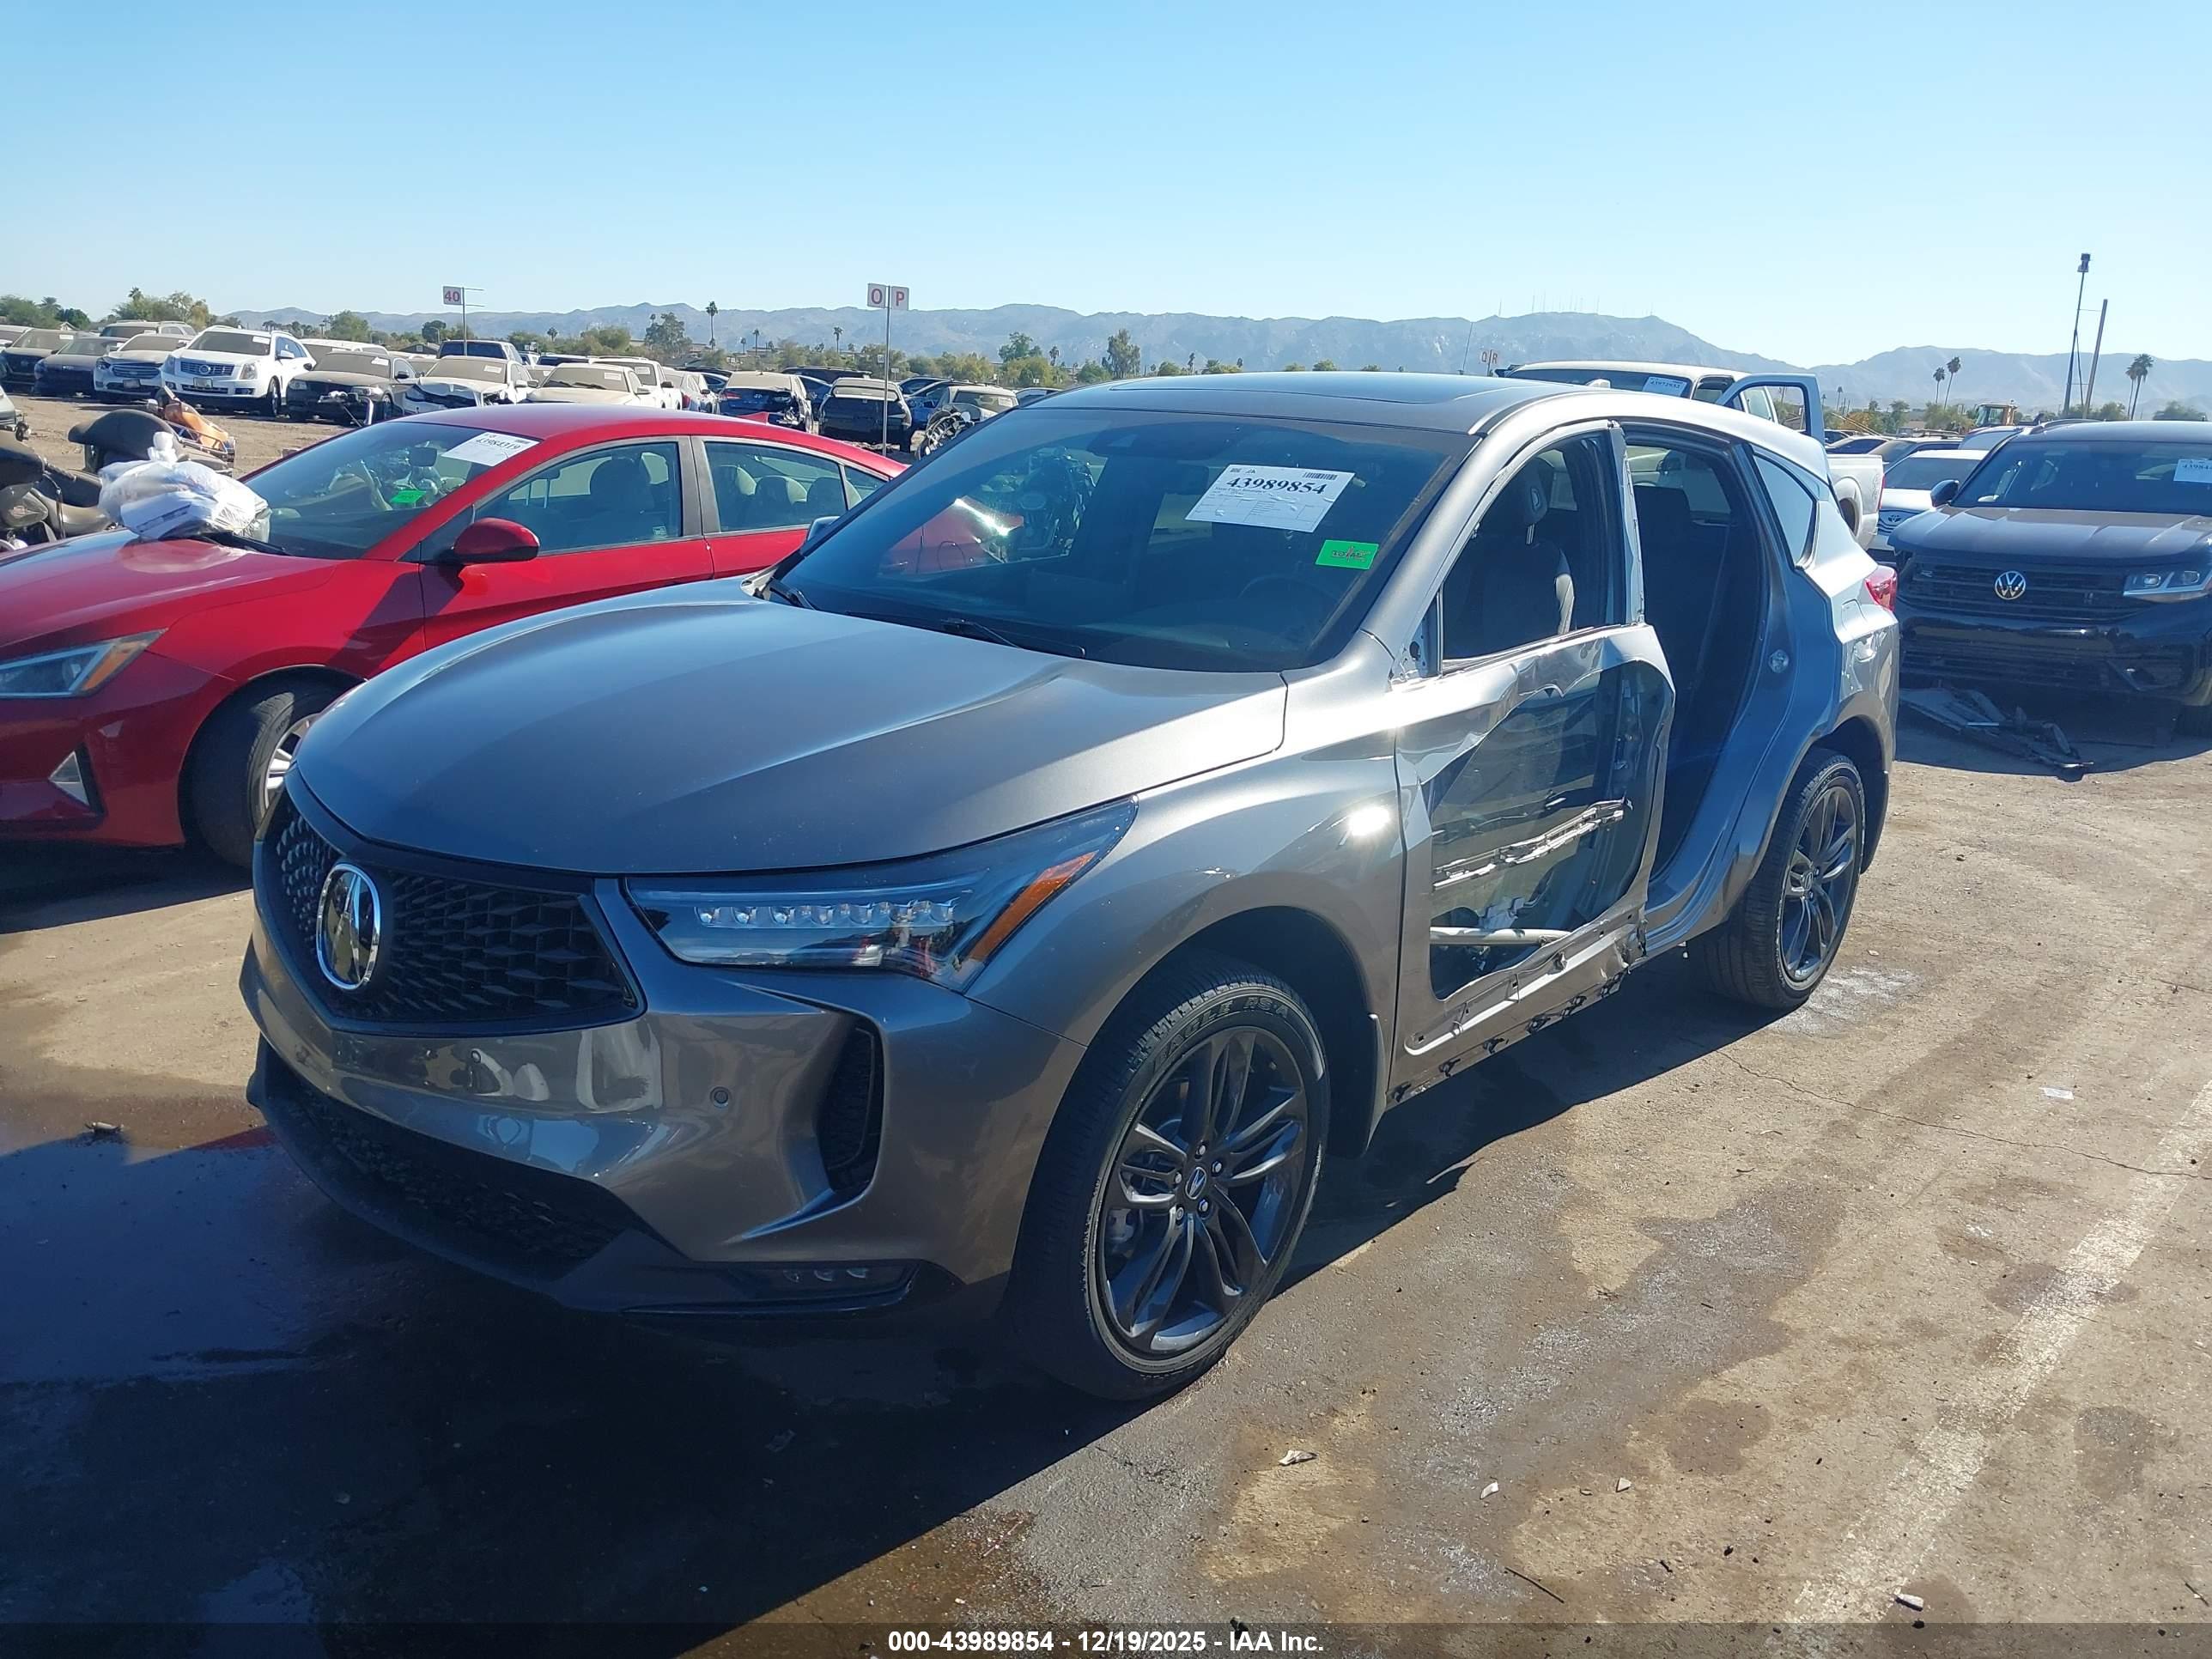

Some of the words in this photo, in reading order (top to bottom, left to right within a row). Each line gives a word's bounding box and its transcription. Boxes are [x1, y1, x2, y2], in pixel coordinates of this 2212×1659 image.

[444, 290, 460, 302] 40
[871, 288, 883, 305] O
[896, 290, 905, 307] P
[1492, 352, 1498, 364] R
[1226, 477, 1328, 495] 43989854
